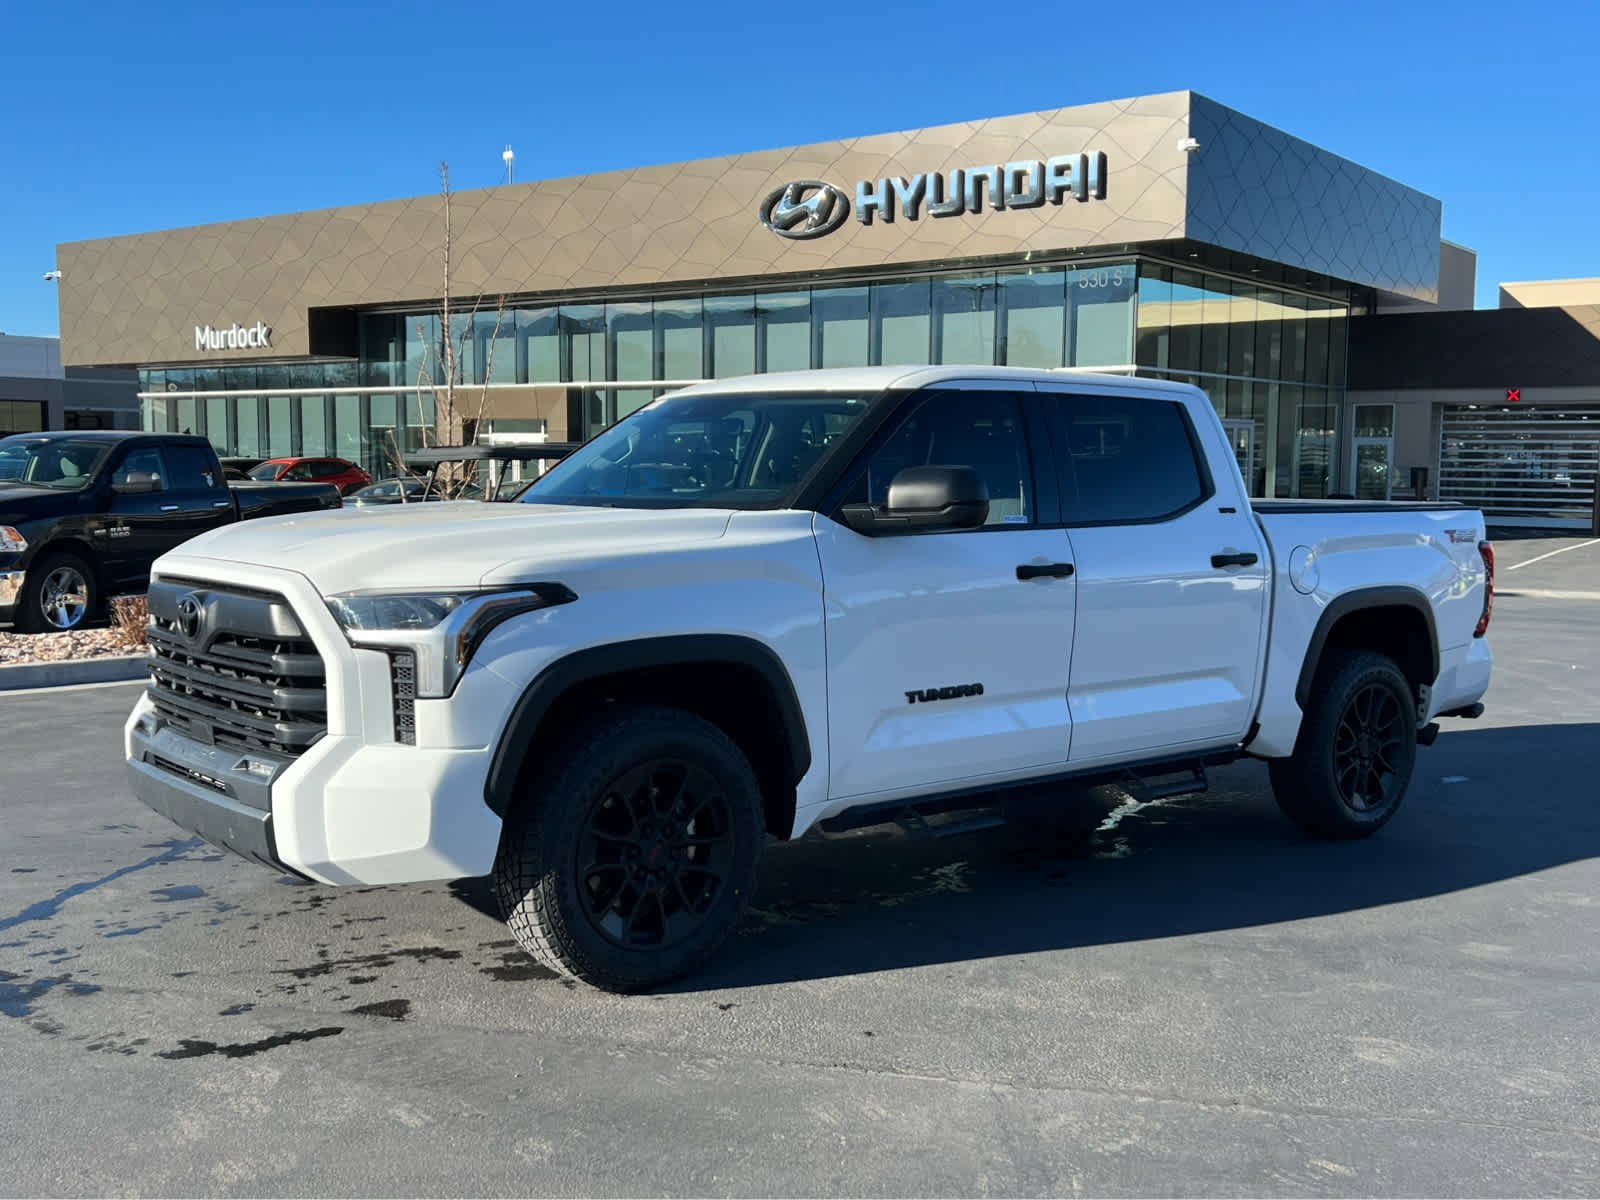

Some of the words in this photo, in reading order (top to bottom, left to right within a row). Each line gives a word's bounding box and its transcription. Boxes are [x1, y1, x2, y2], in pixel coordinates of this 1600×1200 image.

[855, 150, 1107, 226] HYUNDAI
[195, 320, 270, 351] Murdock
[904, 682, 984, 704] TUNDRA
